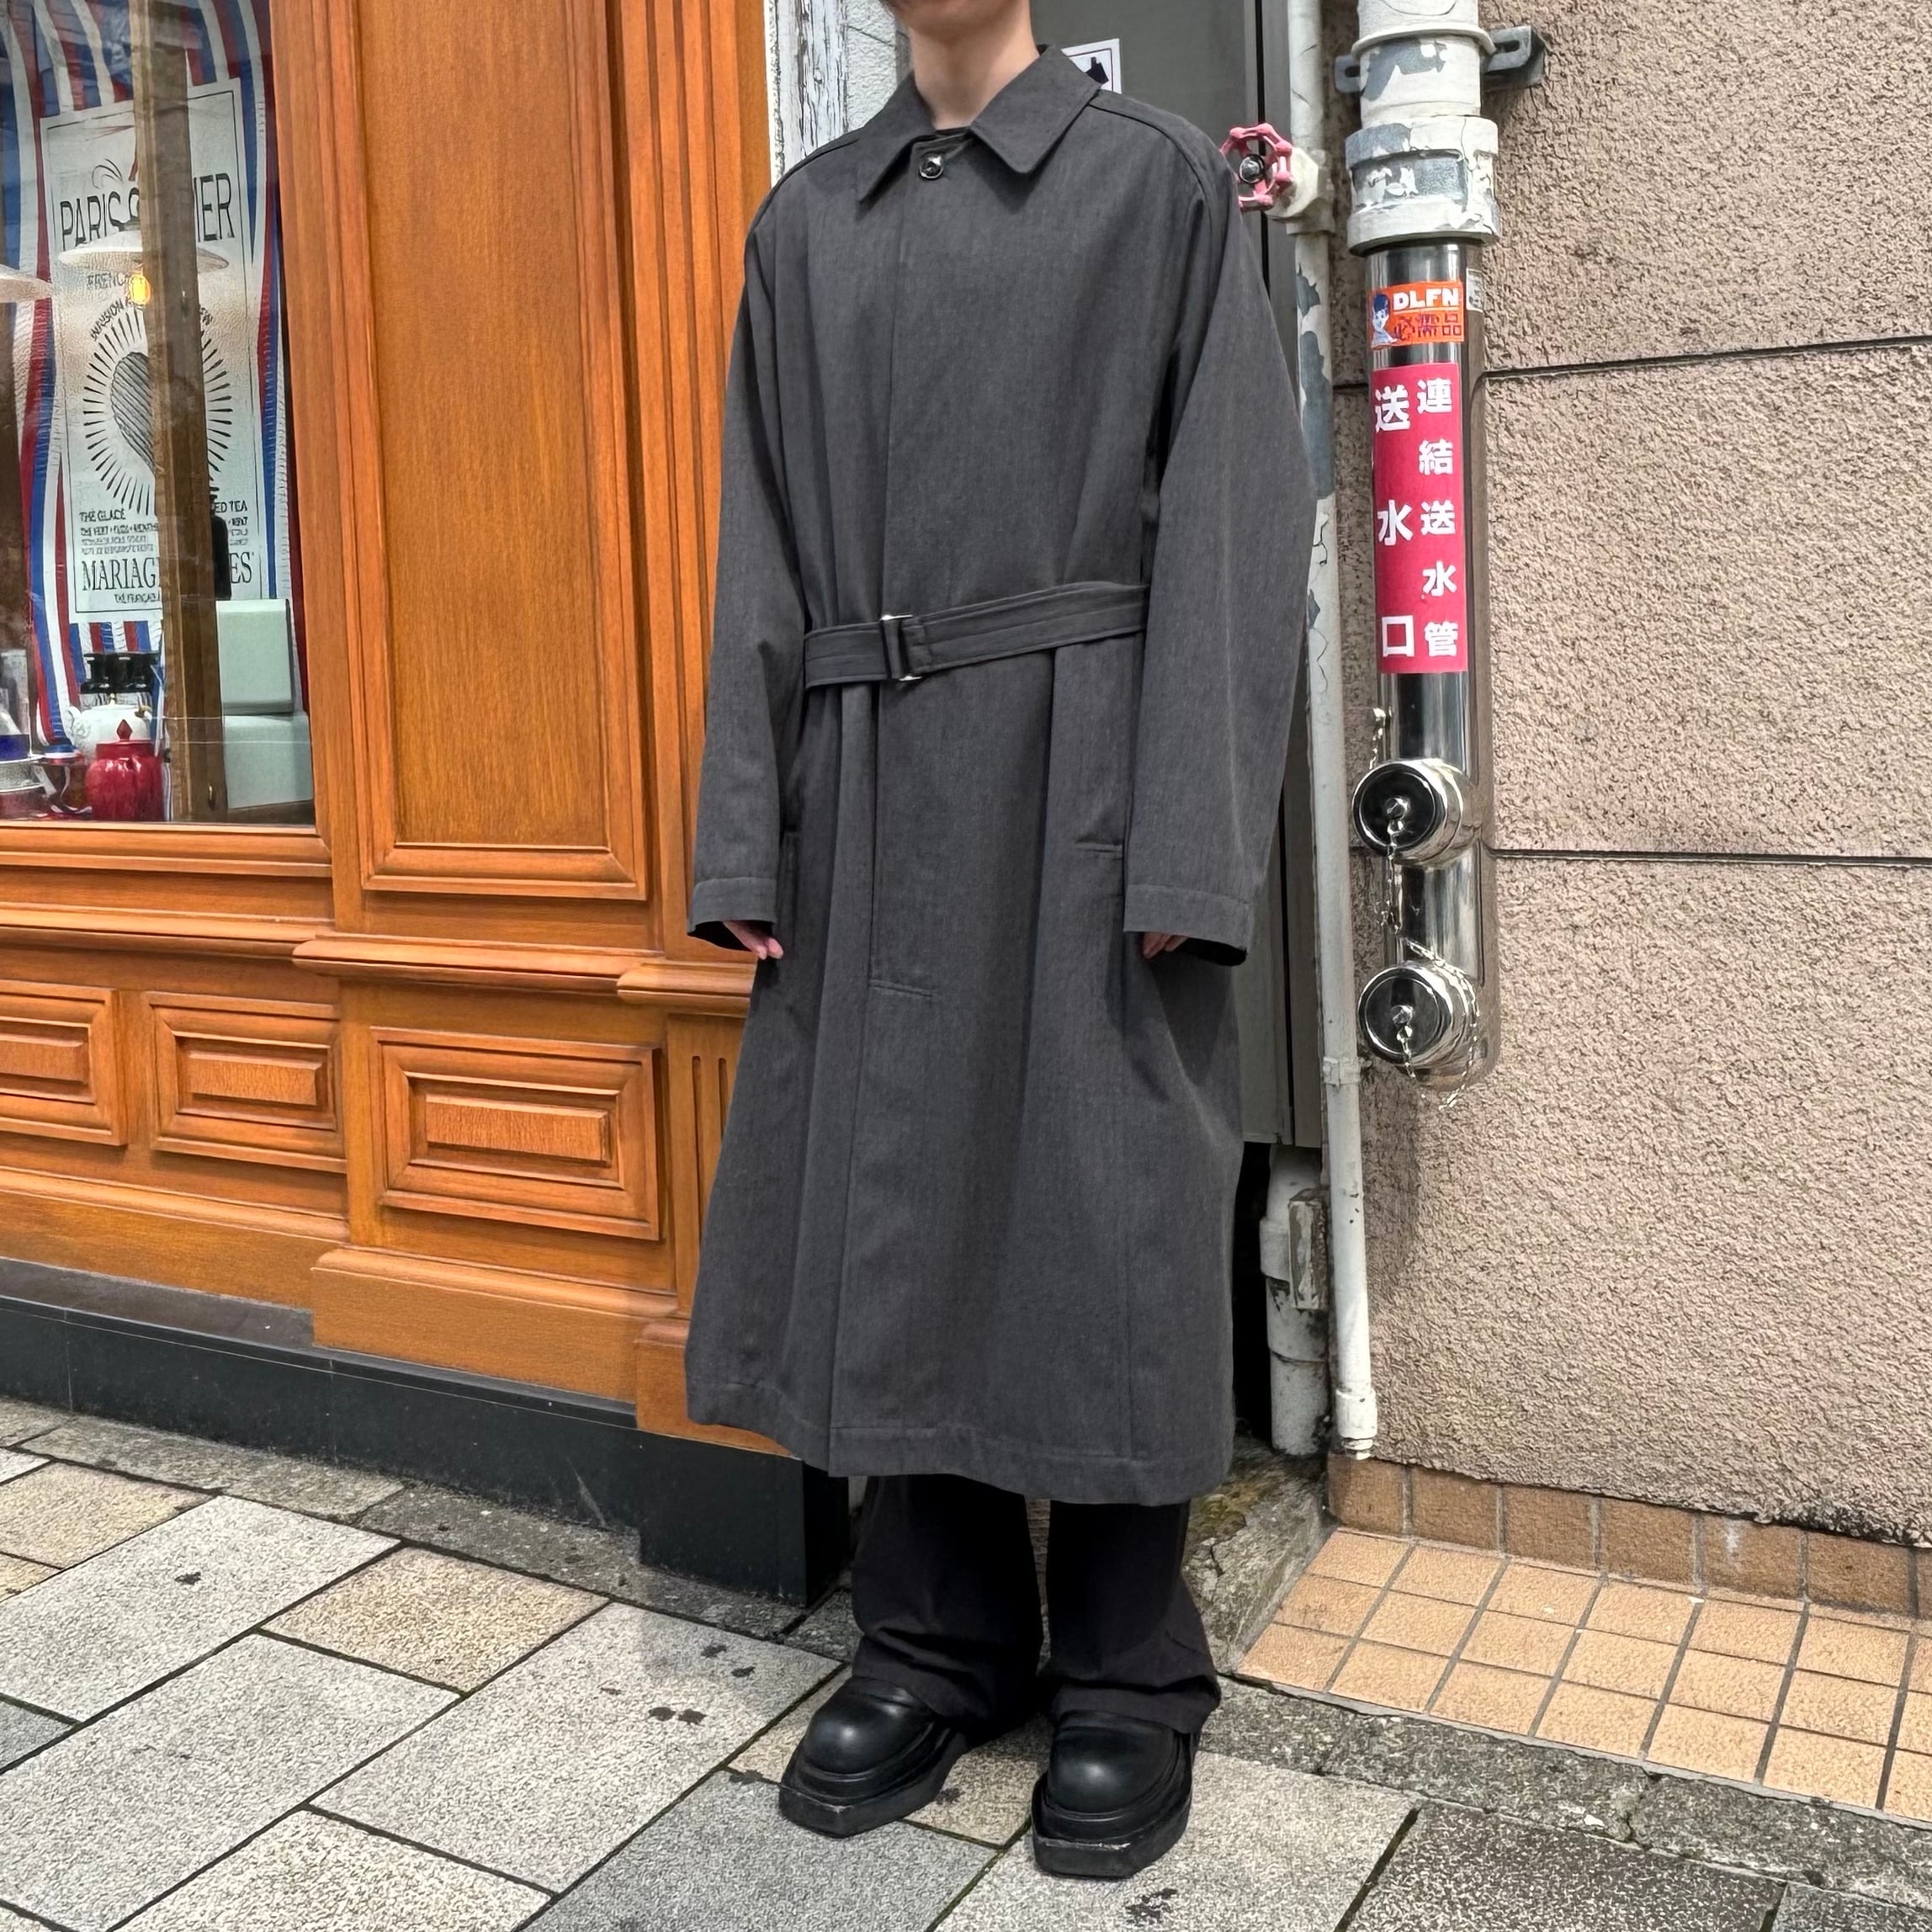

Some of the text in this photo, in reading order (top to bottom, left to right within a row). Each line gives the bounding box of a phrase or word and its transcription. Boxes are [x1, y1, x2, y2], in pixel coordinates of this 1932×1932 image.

[1393, 288, 1460, 310] DLFN
[82, 556, 160, 591] MARIAG
[1375, 385, 1415, 658] 送水口
[1416, 378, 1459, 657] 連結送水管
